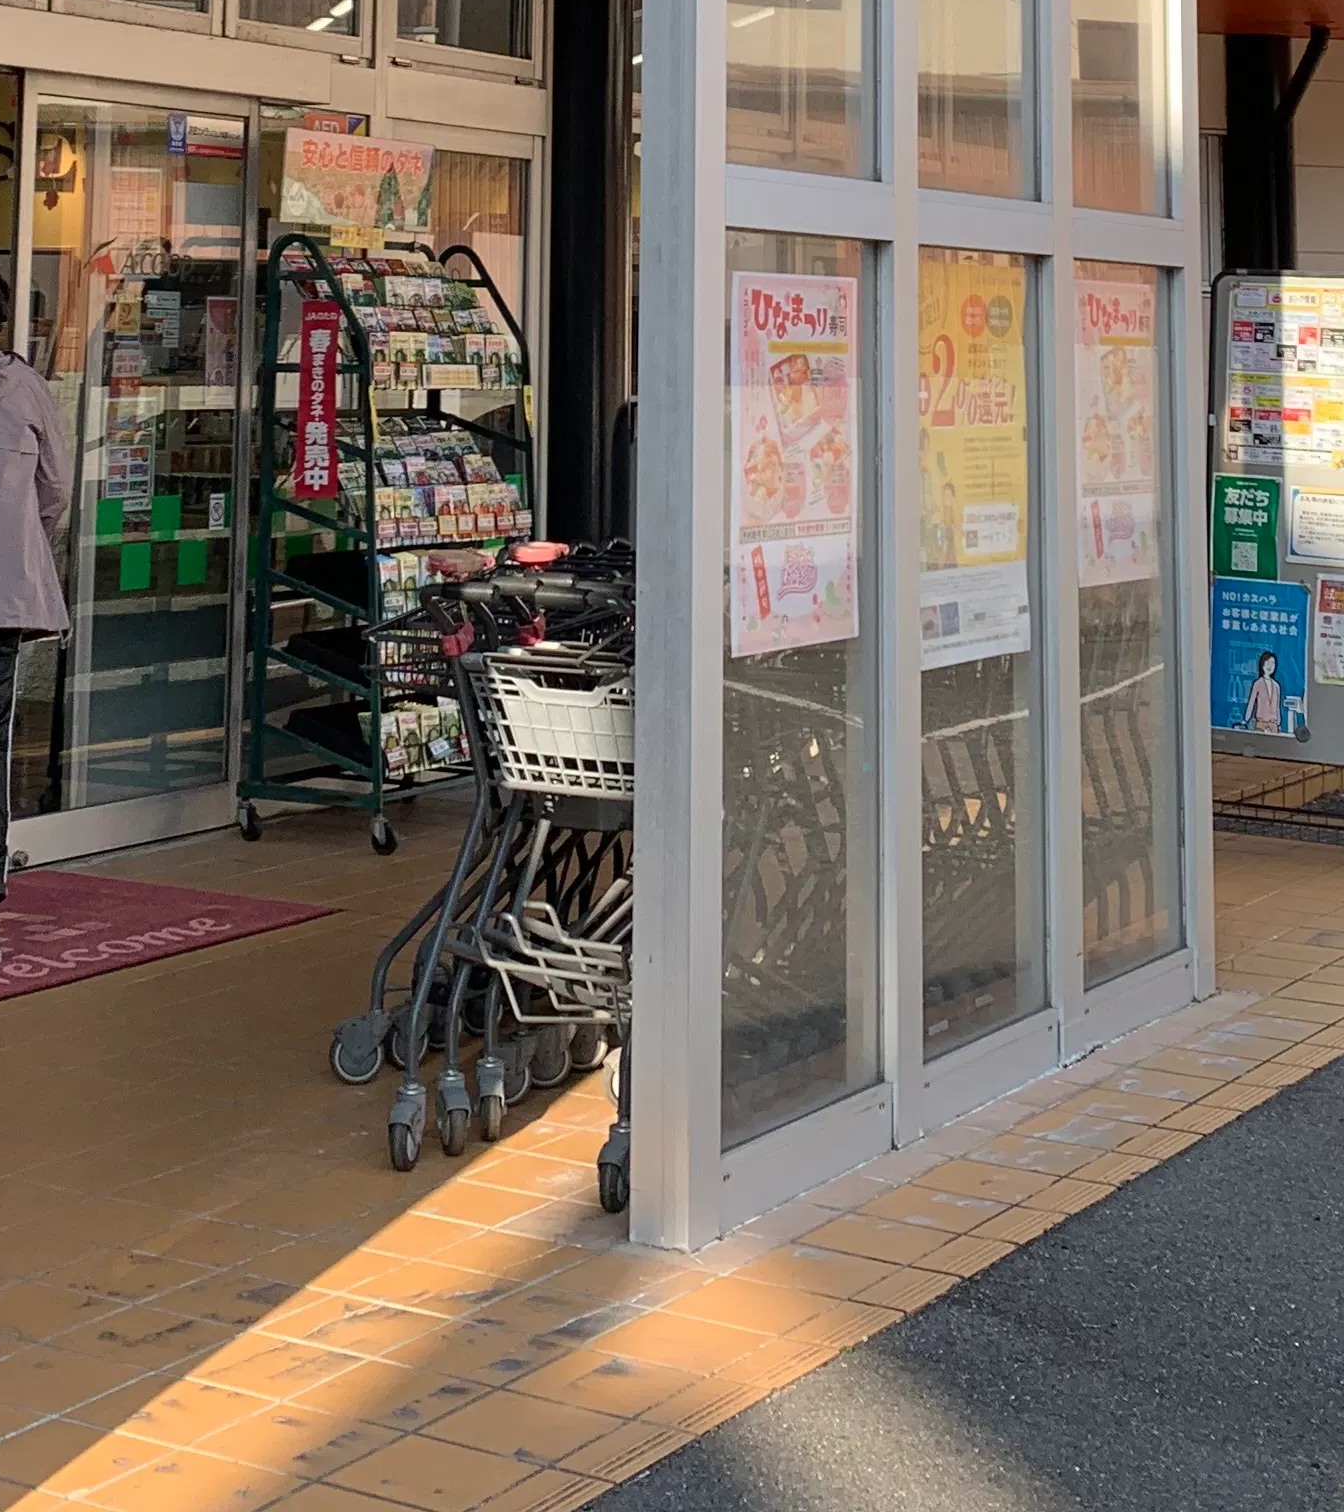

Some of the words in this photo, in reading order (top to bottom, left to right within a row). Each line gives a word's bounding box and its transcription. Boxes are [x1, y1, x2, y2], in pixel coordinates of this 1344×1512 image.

[1223, 487, 1271, 508] 友だち
[1223, 506, 1269, 527] 募集中
[1222, 607, 1300, 624] お客様と従業員が
[1222, 619, 1299, 637] 尊重しあえる社会
